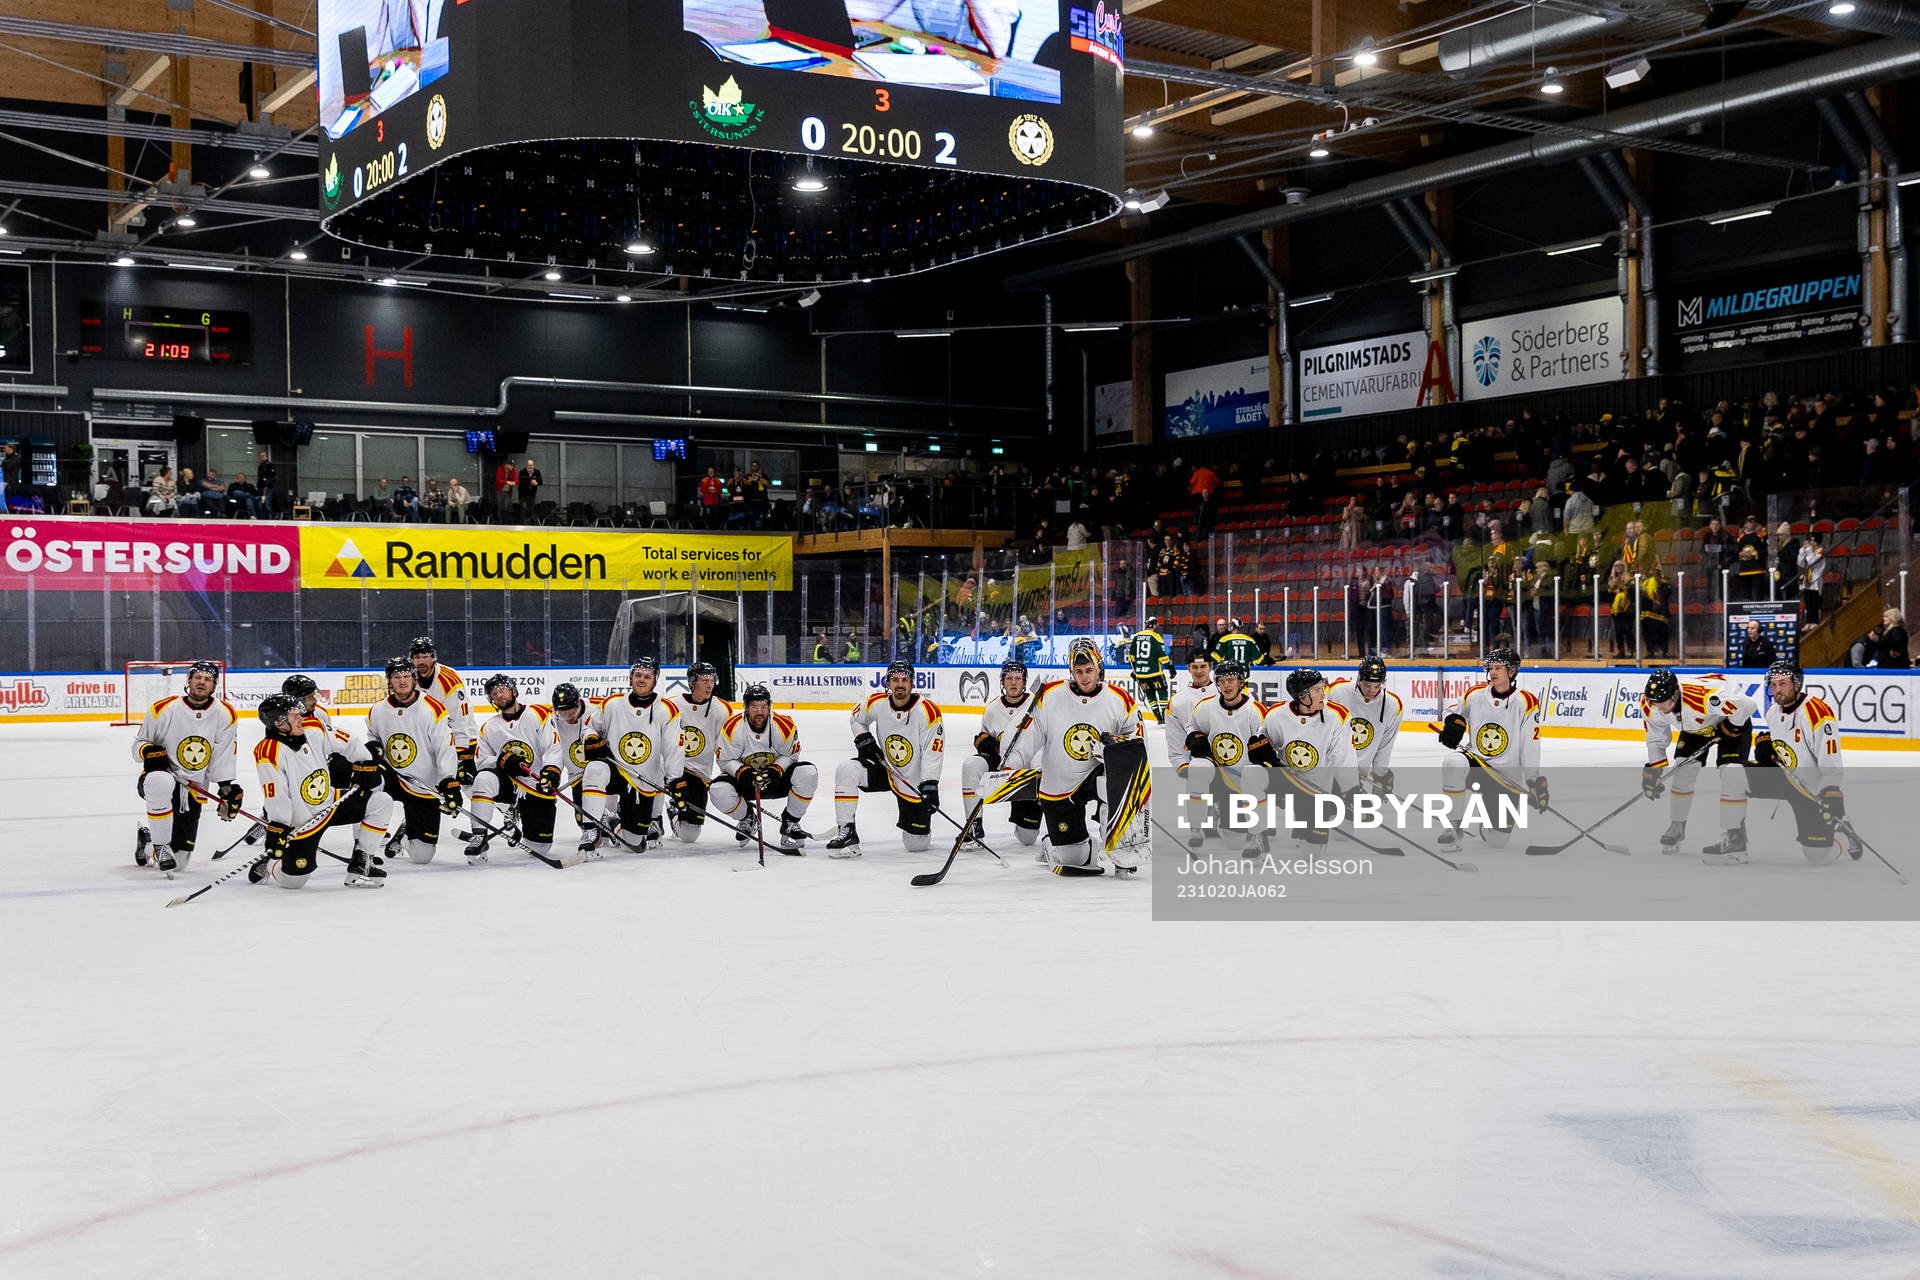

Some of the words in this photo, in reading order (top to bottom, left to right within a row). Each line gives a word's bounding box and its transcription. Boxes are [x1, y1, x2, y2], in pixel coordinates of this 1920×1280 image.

[875, 88, 890, 111] 3
[755, 108, 765, 122] IK
[1023, 114, 1038, 122] 1912
[377, 120, 384, 142] 3
[801, 117, 825, 150] 0
[842, 123, 921, 159] 20:00
[935, 132, 957, 165] 2
[354, 167, 362, 197] 0
[366, 151, 394, 190] 20:00
[398, 143, 408, 176] 2
[1706, 274, 1861, 319] MILDEGRUPPEN
[123, 308, 132, 320] H
[201, 313, 210, 325] G
[1511, 319, 1609, 354] Söderberg
[145, 343, 190, 358] 21:09
[365, 324, 412, 388] H
[1304, 341, 1411, 376] PILGRIMSTADS
[1417, 341, 1456, 406] A
[1511, 360, 1525, 382] &
[1530, 348, 1610, 378] Partners
[1303, 371, 1422, 403] CEMENTVARUFABRI
[1236, 412, 1262, 423] BADET
[5, 526, 291, 574] ÖSTERSUND
[642, 546, 677, 560] Total
[681, 548, 739, 560] services
[743, 548, 761, 561] for
[386, 541, 606, 579] Ramudden
[643, 567, 677, 580] work
[1136, 641, 1151, 658] 19
[1233, 646, 1245, 663] 11
[67, 682, 100, 694] drive
[104, 682, 115, 694] in
[333, 689, 387, 704] JACKPO
[525, 687, 541, 696] AB
[1550, 686, 1588, 702] Svensk
[64, 695, 120, 708] ARENABYN
[1555, 702, 1585, 718] Cater
[931, 738, 943, 752] 52
[263, 783, 275, 798] 19
